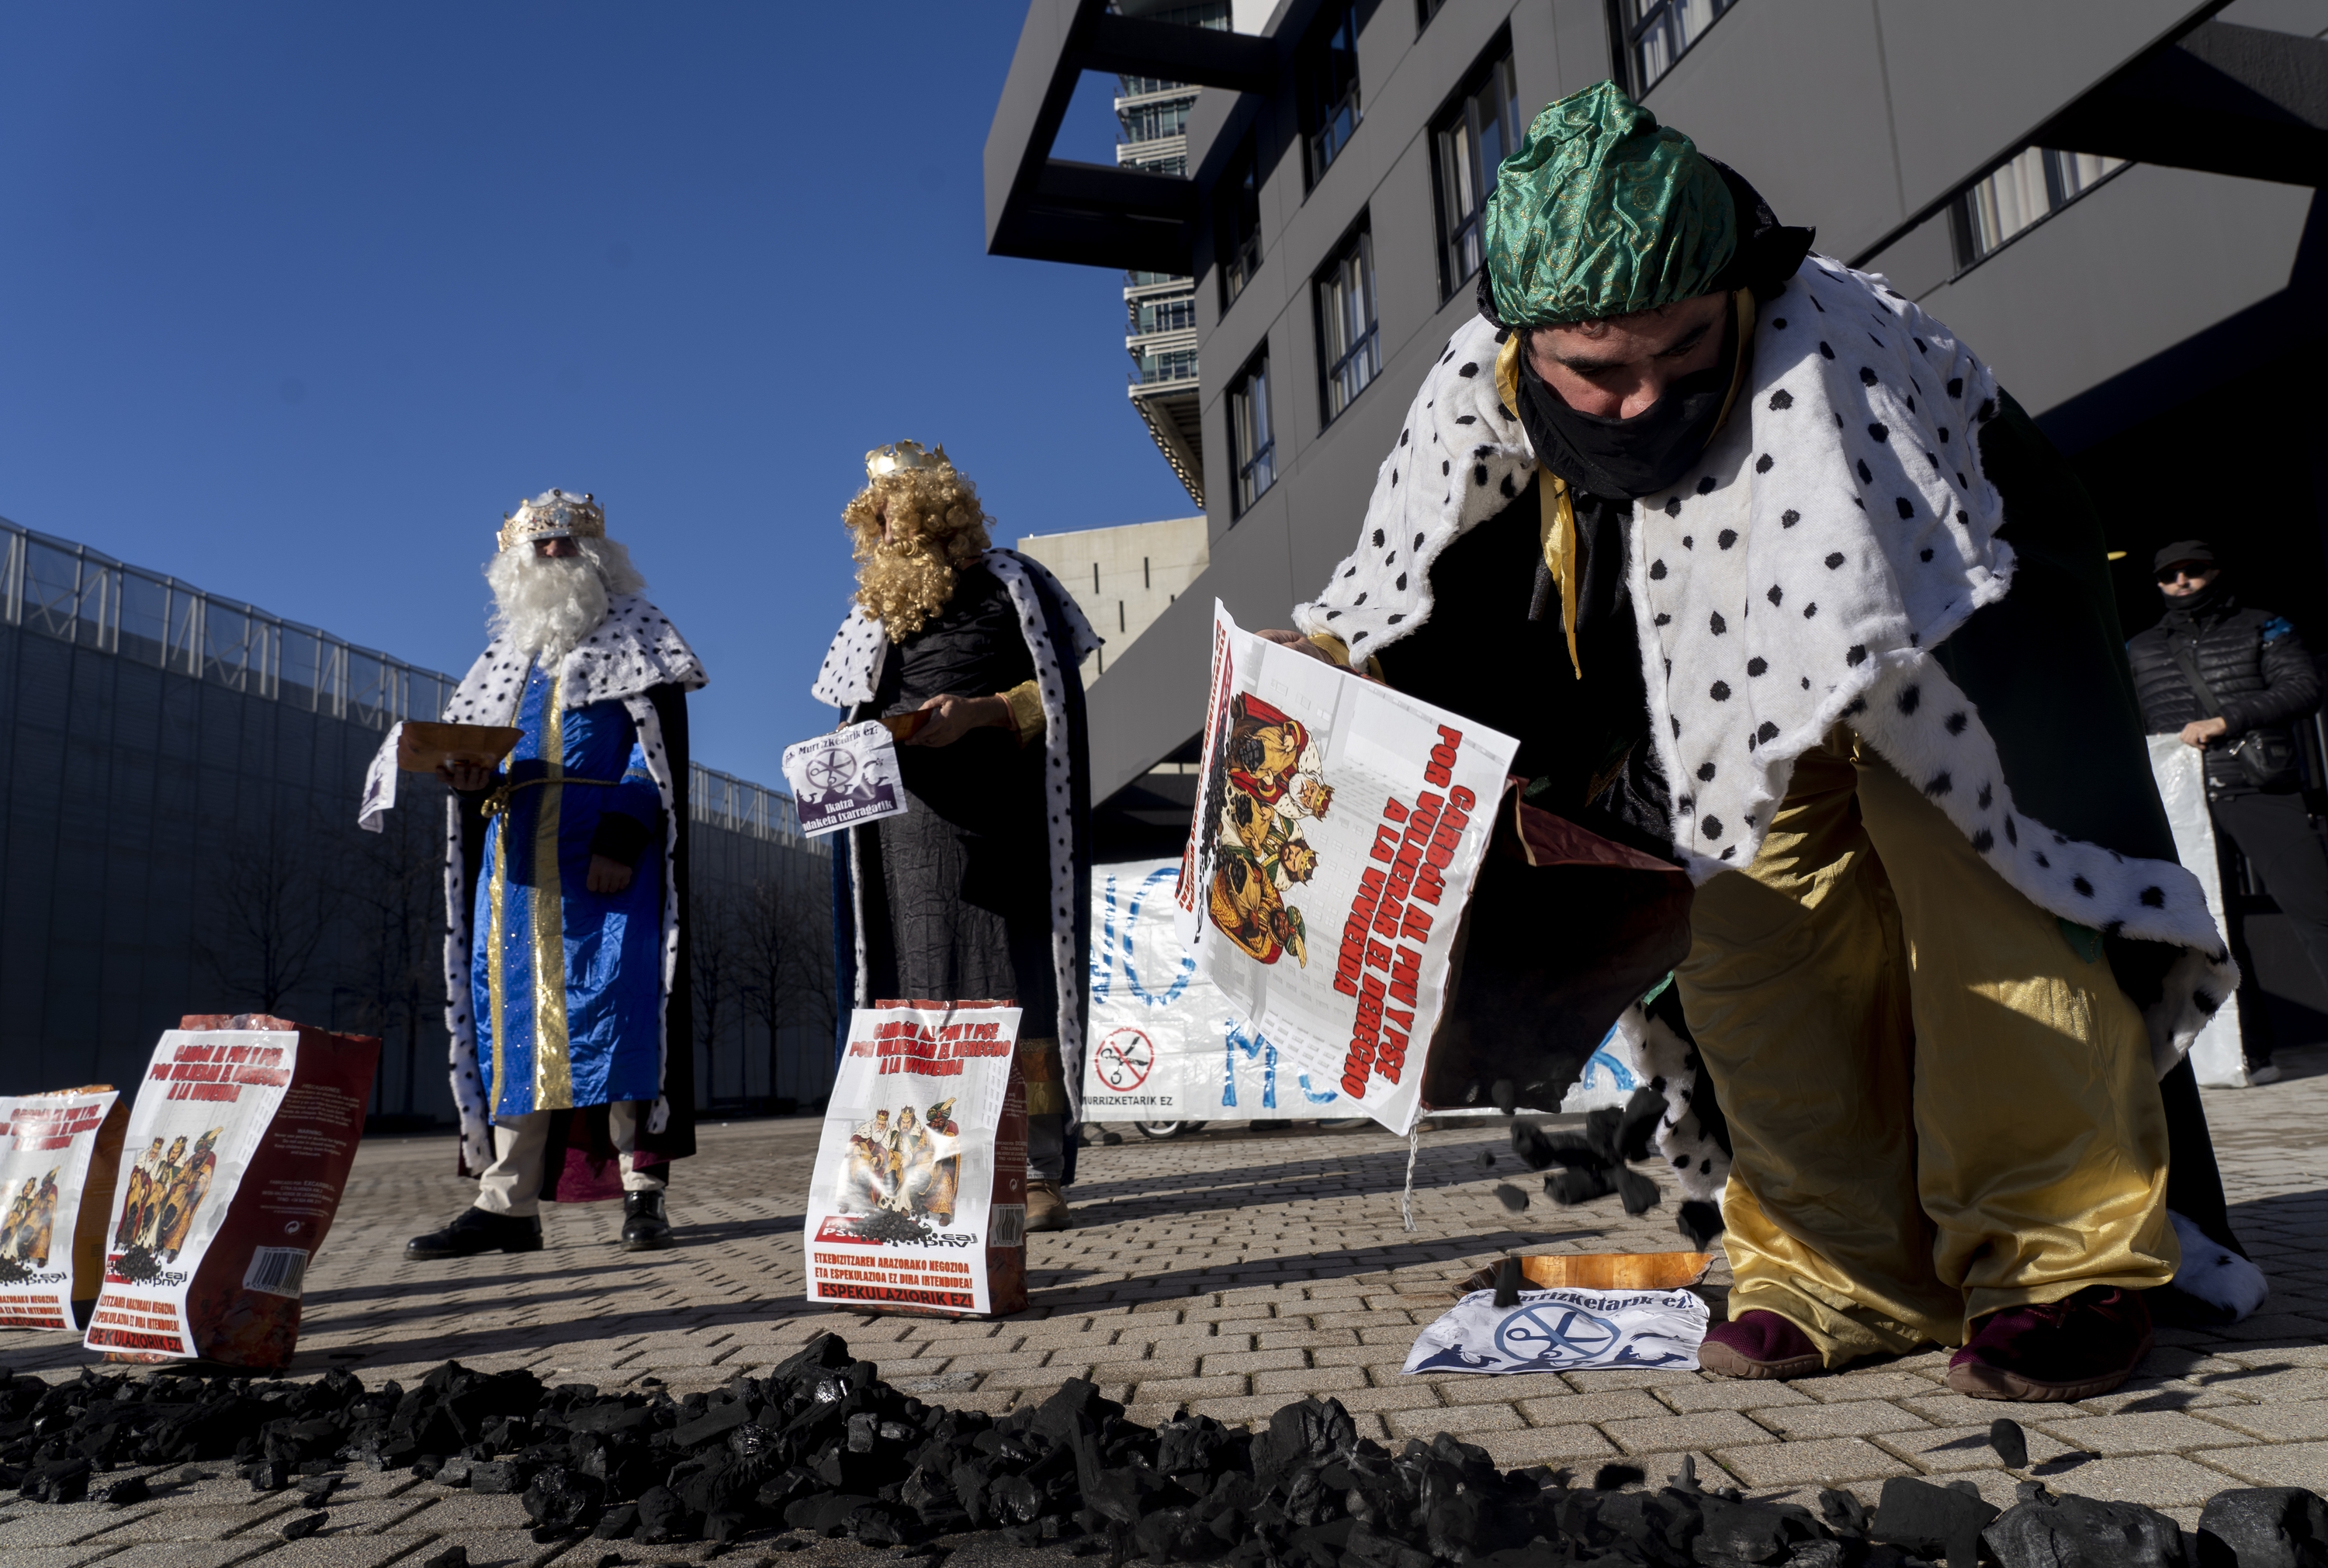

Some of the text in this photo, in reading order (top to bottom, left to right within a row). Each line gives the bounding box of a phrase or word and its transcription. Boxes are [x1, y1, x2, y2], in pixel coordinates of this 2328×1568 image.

[825, 799, 854, 814] Ikatza
[838, 800, 893, 823] txarragatik
[1333, 797, 1409, 998] A LA VIVIENDA
[1341, 724, 1463, 1100] POR VULNERAR EL DERECHO
[1400, 903, 1434, 944] AL
[1388, 945, 1422, 1009] PNV
[1385, 1006, 1415, 1032] Y
[919, 1026, 936, 1041] AL
[939, 1023, 963, 1042] PNV
[965, 1023, 975, 1039] Y
[973, 1023, 999, 1040] PSE
[211, 1046, 227, 1063] AL
[225, 1045, 252, 1064] PNV
[250, 1047, 262, 1064] Y
[258, 1048, 283, 1067] PSE
[849, 1039, 1011, 1059] POR VULNERAR EL DERECHO
[1374, 1026, 1409, 1085] PSE
[148, 1064, 290, 1087] POR VULNERAR EL DERECHO
[879, 1057, 964, 1076] A LA VIVIENDA
[167, 1083, 243, 1102] A LA VIVIENDA
[1160, 1096, 1173, 1106] EZ
[814, 1252, 970, 1275] ETXEBIZITZAREN ARAZORAKO NEGOZIOA
[815, 1267, 973, 1289] ETA ESPEKULAZIOA EZ DIRA IRTENBIDEA!
[30, 1295, 59, 1304] NEGOZIOA
[822, 1284, 973, 1309] ESPEKULAZIORIK EZ!
[1519, 1291, 1694, 1311] urrizketarik ez!
